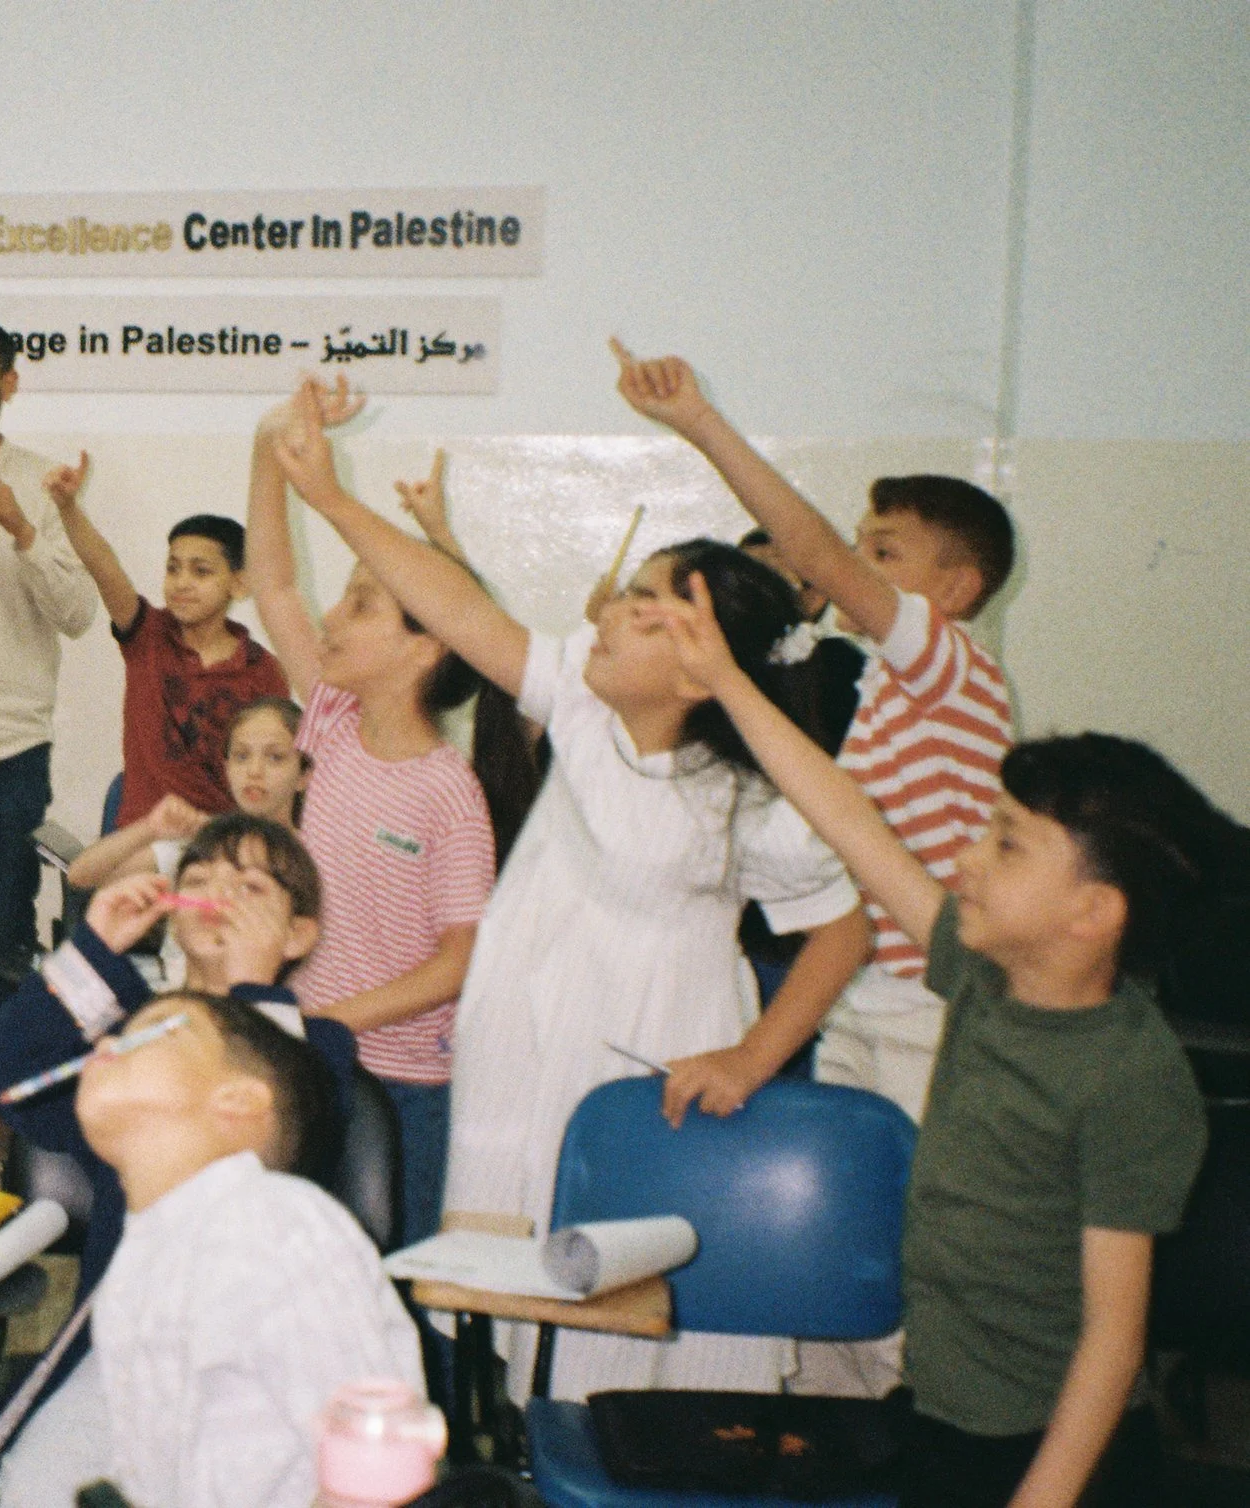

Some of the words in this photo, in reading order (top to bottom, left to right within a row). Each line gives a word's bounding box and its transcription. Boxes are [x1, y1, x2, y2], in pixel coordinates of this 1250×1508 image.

[183, 212, 305, 250] Center
[311, 214, 342, 249] In
[350, 210, 522, 249] Palestine
[80, 325, 110, 354] in
[122, 325, 282, 355] Palestine
